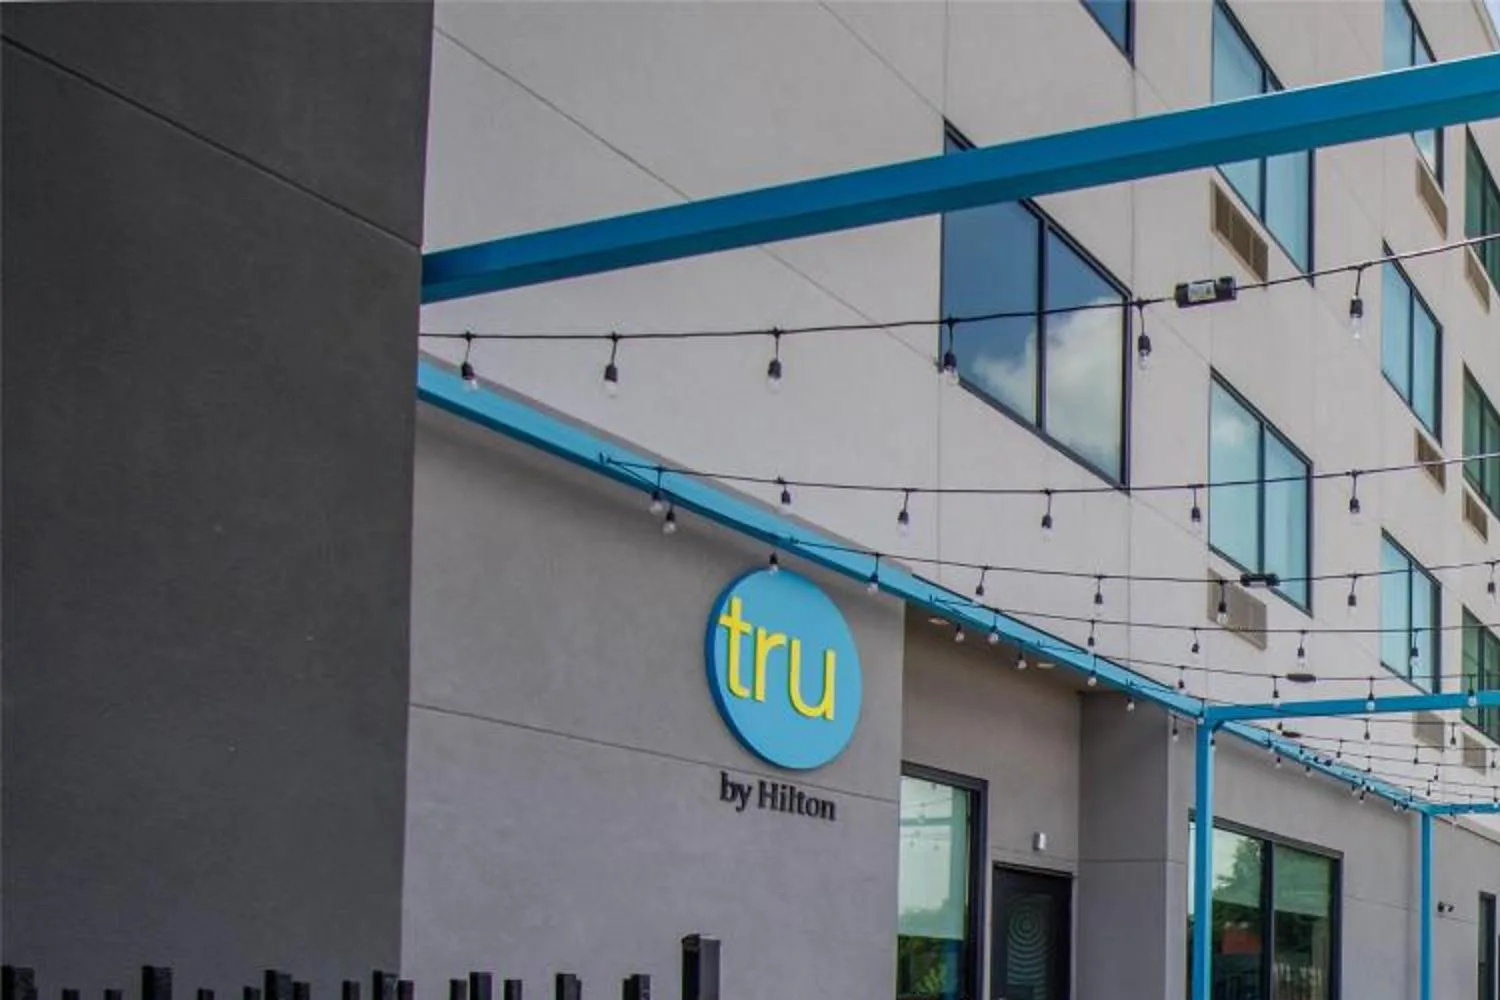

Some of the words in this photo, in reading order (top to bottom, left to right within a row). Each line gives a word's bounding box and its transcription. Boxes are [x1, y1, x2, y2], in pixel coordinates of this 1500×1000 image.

[719, 596, 836, 720] tru
[720, 771, 752, 812] by
[758, 780, 837, 821] Hilton
